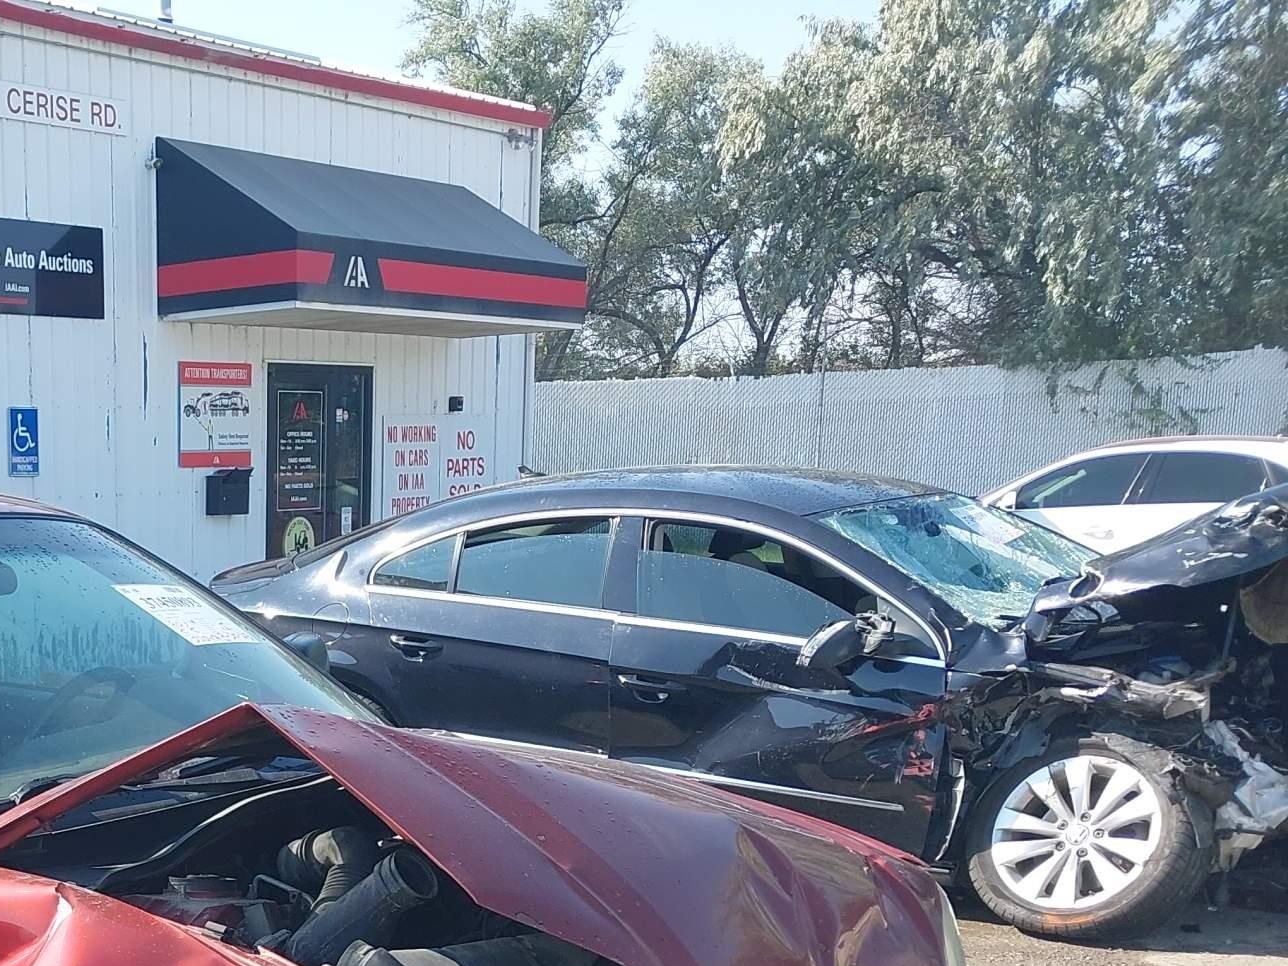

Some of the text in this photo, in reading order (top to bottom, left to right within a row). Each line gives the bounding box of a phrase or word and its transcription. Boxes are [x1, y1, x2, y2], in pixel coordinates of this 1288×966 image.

[7, 87, 81, 123] CERISE
[90, 101, 122, 129] RD.
[4, 248, 35, 269] Auto
[38, 250, 94, 274] Auctions
[387, 425, 436, 443] NO WORKING
[457, 430, 475, 450] NO
[395, 449, 429, 467] ON CARS
[446, 456, 485, 477] PARTS
[398, 473, 425, 491] ON IAA
